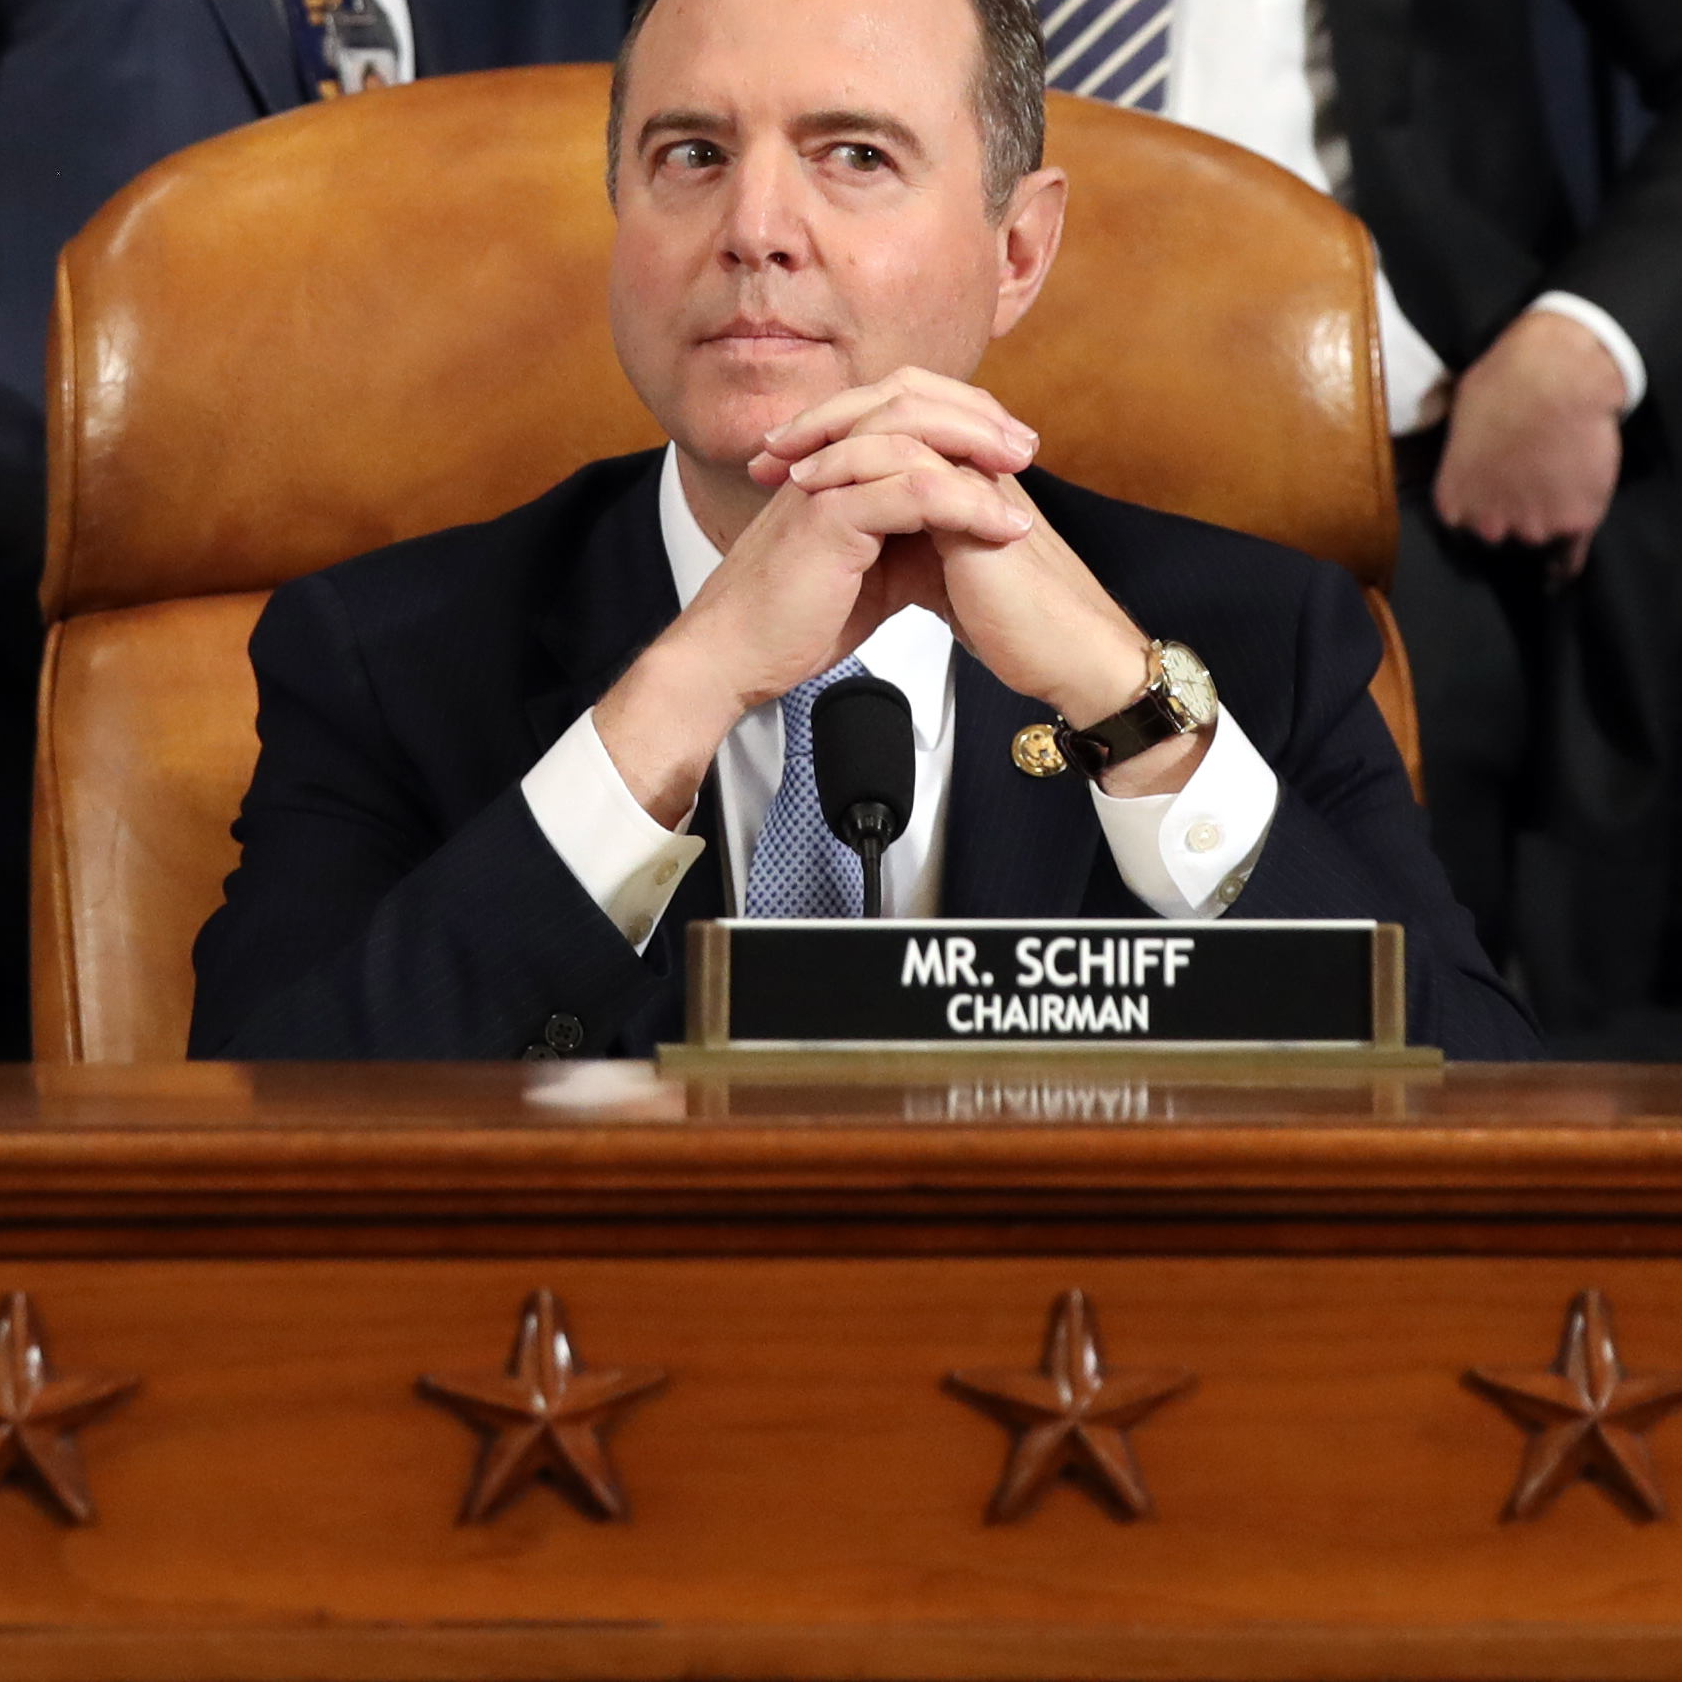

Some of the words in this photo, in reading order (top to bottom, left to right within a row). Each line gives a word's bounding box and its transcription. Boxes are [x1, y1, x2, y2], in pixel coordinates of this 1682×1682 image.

[901, 936, 994, 987] MR.
[1015, 936, 1195, 987] SCHIFF
[946, 993, 1149, 1033] CHAIRMAN
